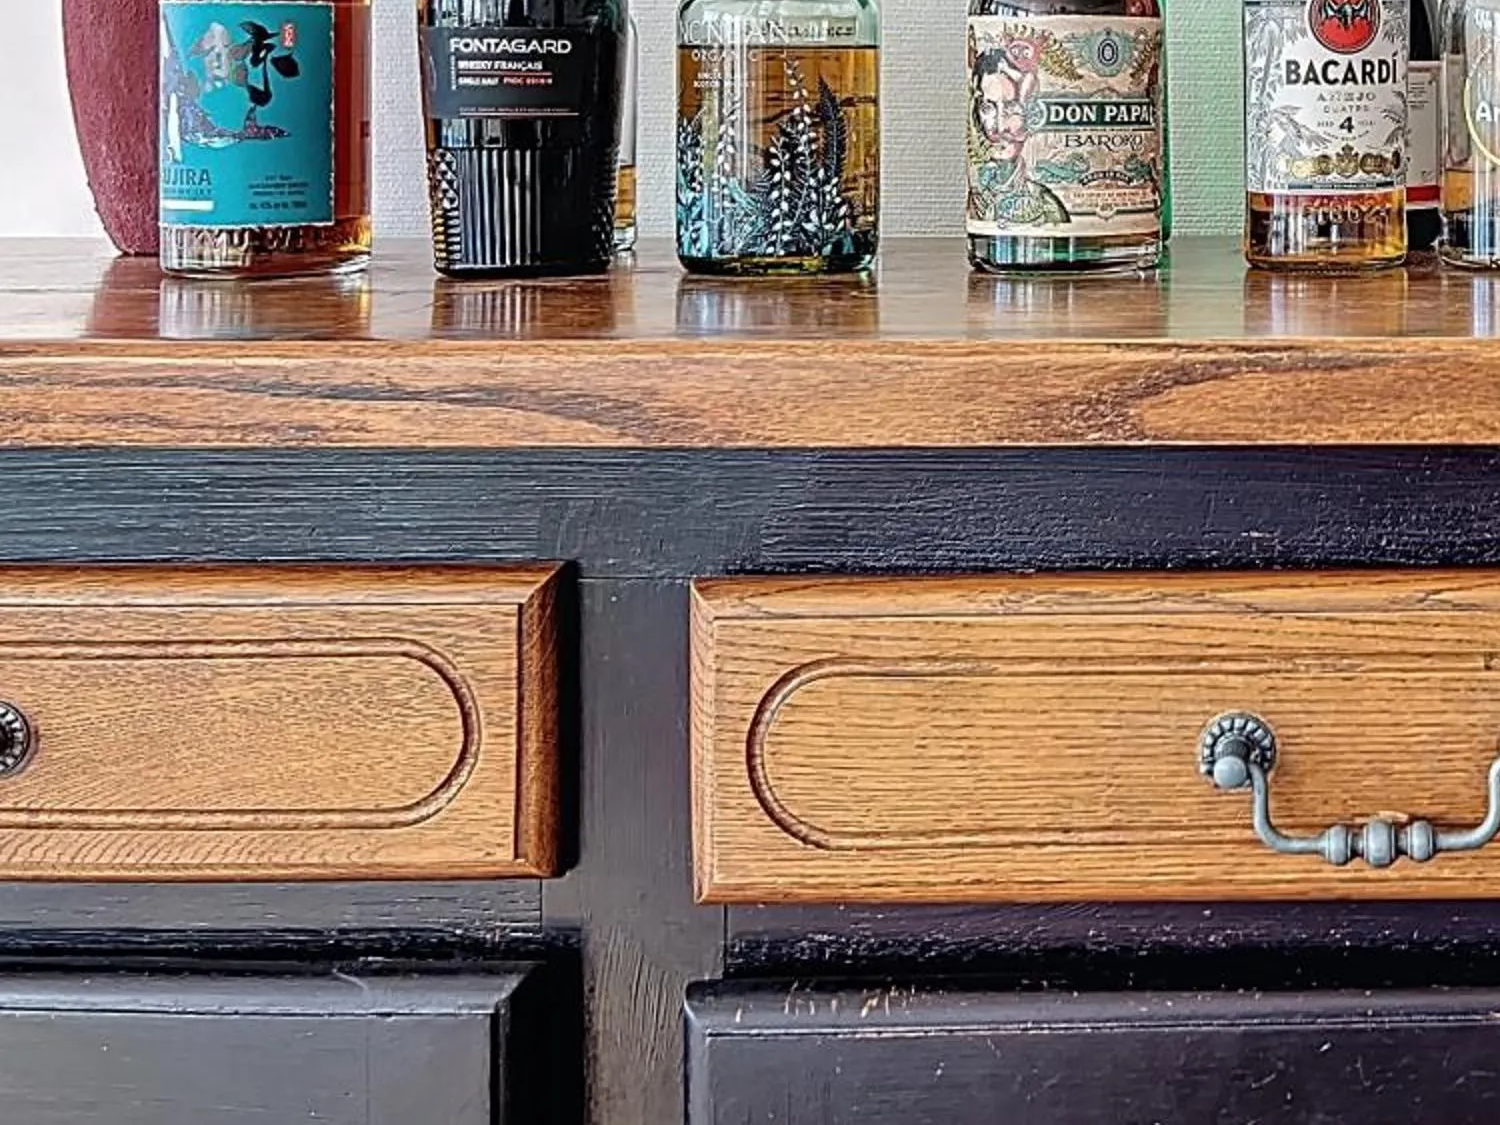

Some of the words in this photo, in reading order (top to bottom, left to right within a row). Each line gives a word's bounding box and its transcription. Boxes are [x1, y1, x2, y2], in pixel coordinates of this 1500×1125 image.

[450, 38, 572, 54] FONTAGARD
[1285, 50, 1398, 86] BACARDÍ
[1049, 104, 1098, 124] DON
[1104, 104, 1150, 123] PAPA
[1339, 115, 1355, 134] 4
